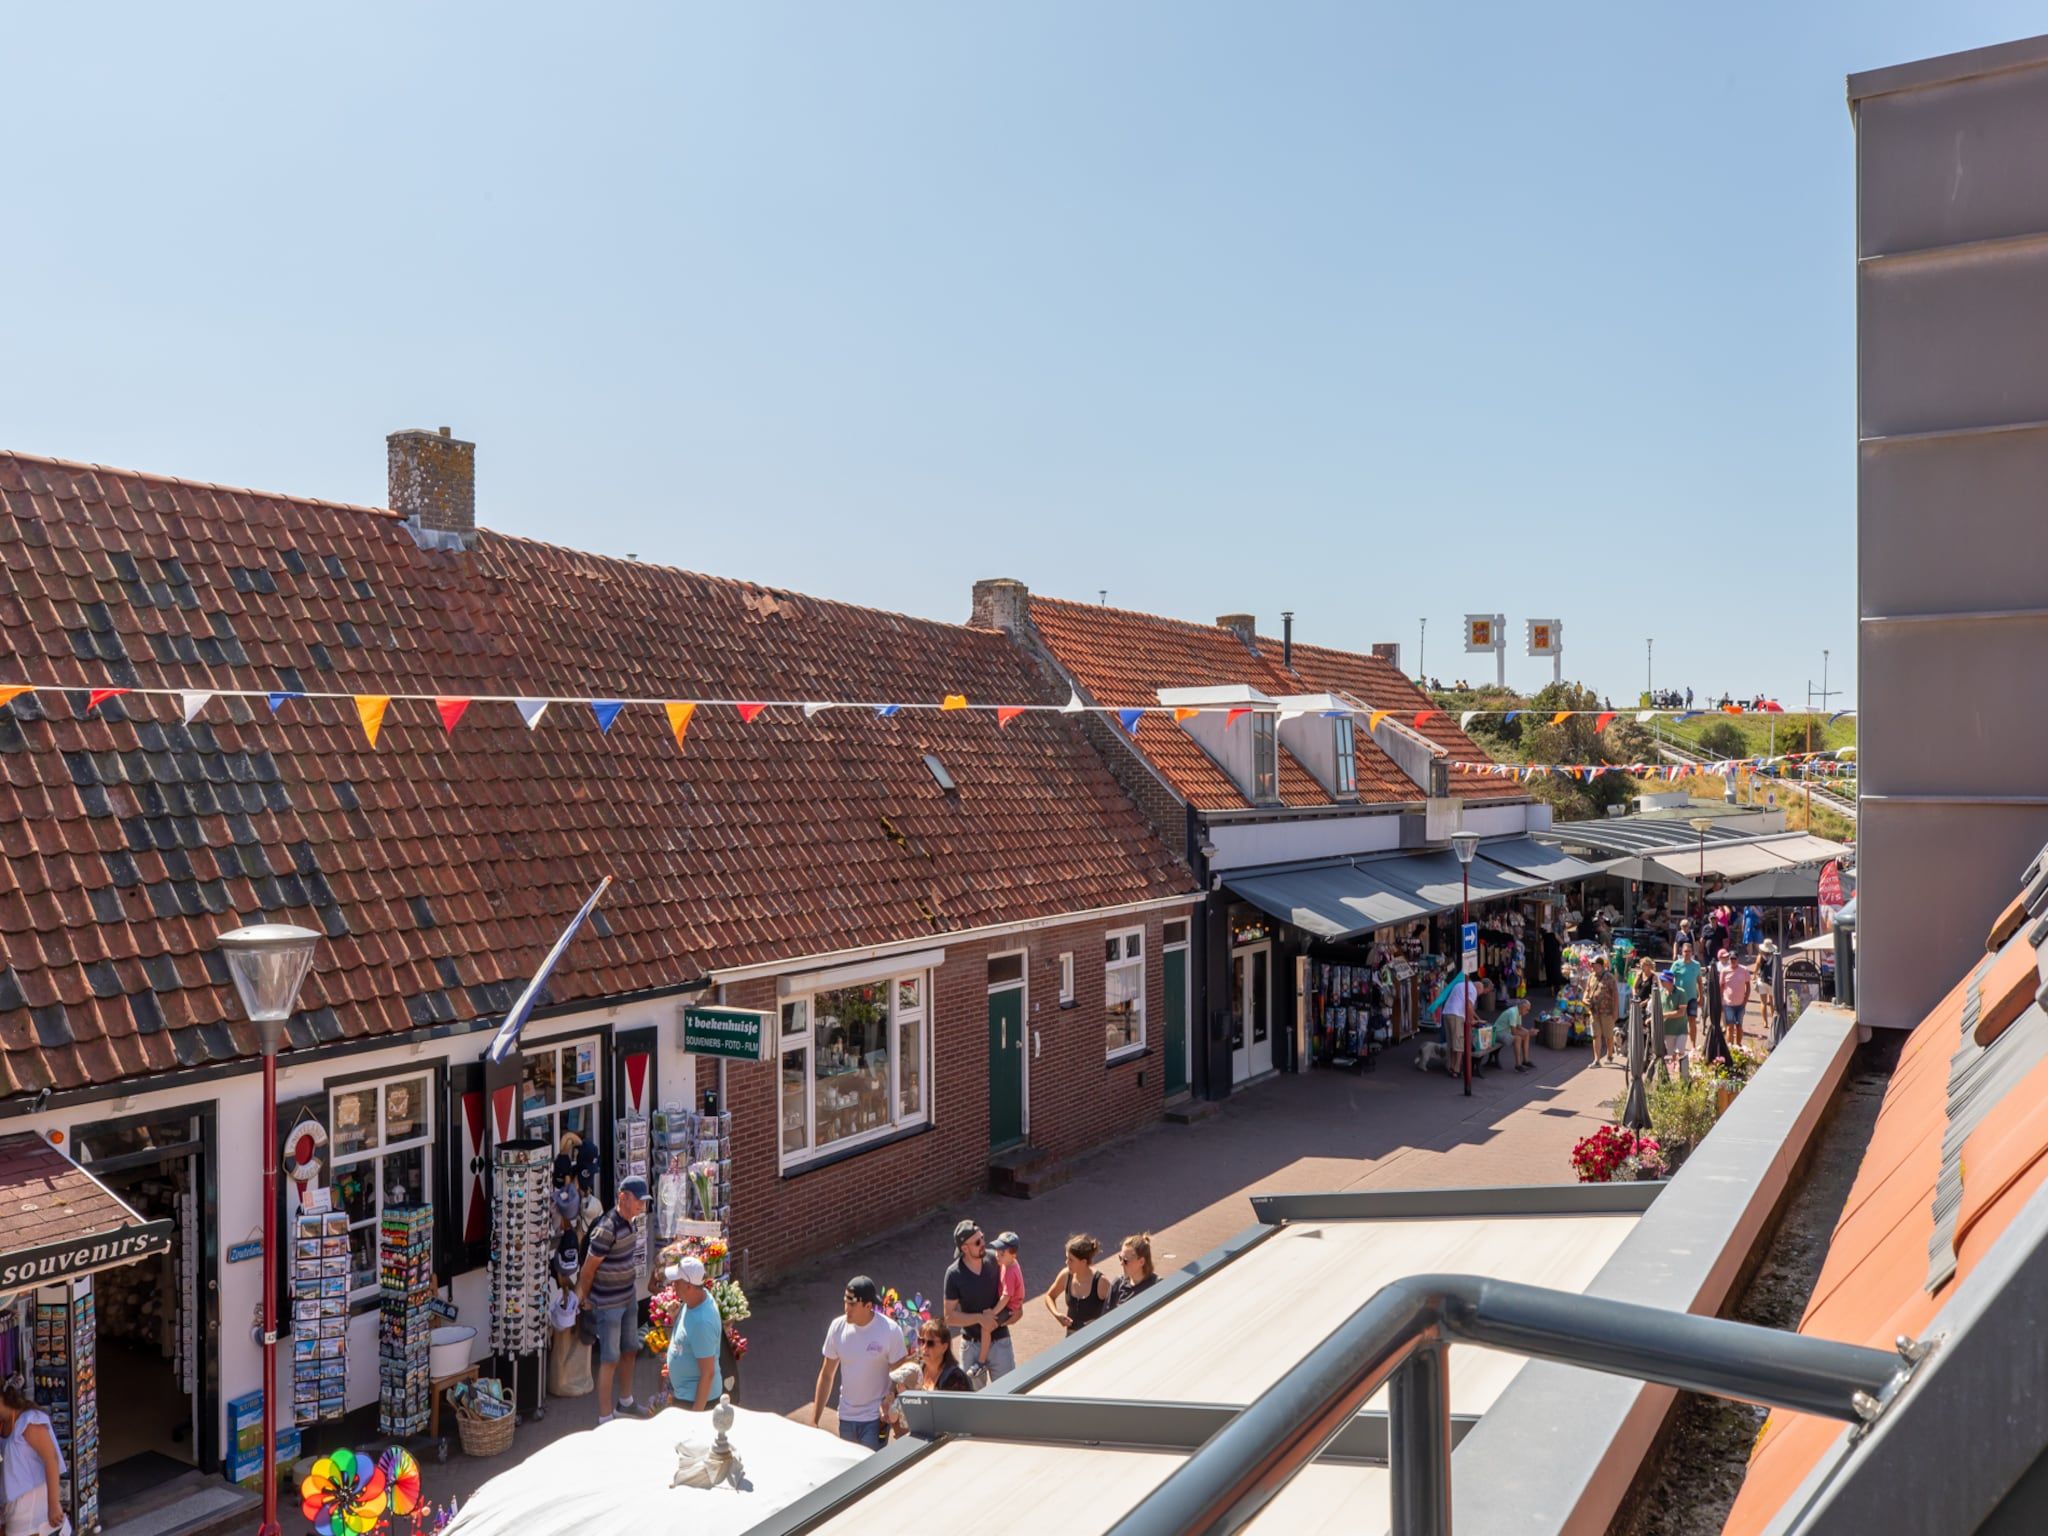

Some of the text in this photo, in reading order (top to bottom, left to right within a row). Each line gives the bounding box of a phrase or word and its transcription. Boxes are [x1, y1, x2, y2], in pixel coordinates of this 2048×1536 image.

[685, 1015, 758, 1036] 't boekenhuisje
[724, 1039, 741, 1050] FOTO
[744, 1041, 759, 1052] FILM
